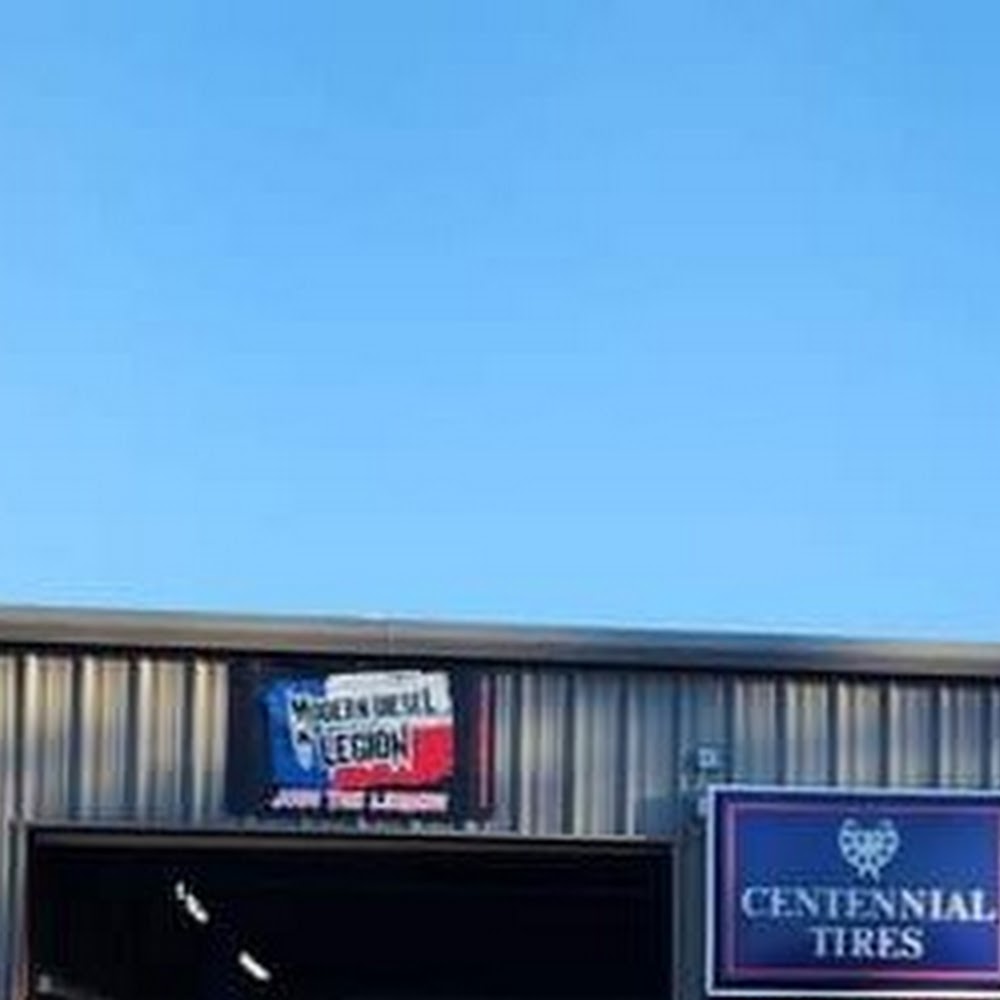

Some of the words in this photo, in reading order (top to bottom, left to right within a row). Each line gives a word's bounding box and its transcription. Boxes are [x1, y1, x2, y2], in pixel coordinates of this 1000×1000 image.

[320, 725, 410, 767] LEGION
[741, 886, 996, 921] CENTENNIAL
[811, 926, 925, 960] TIRES
